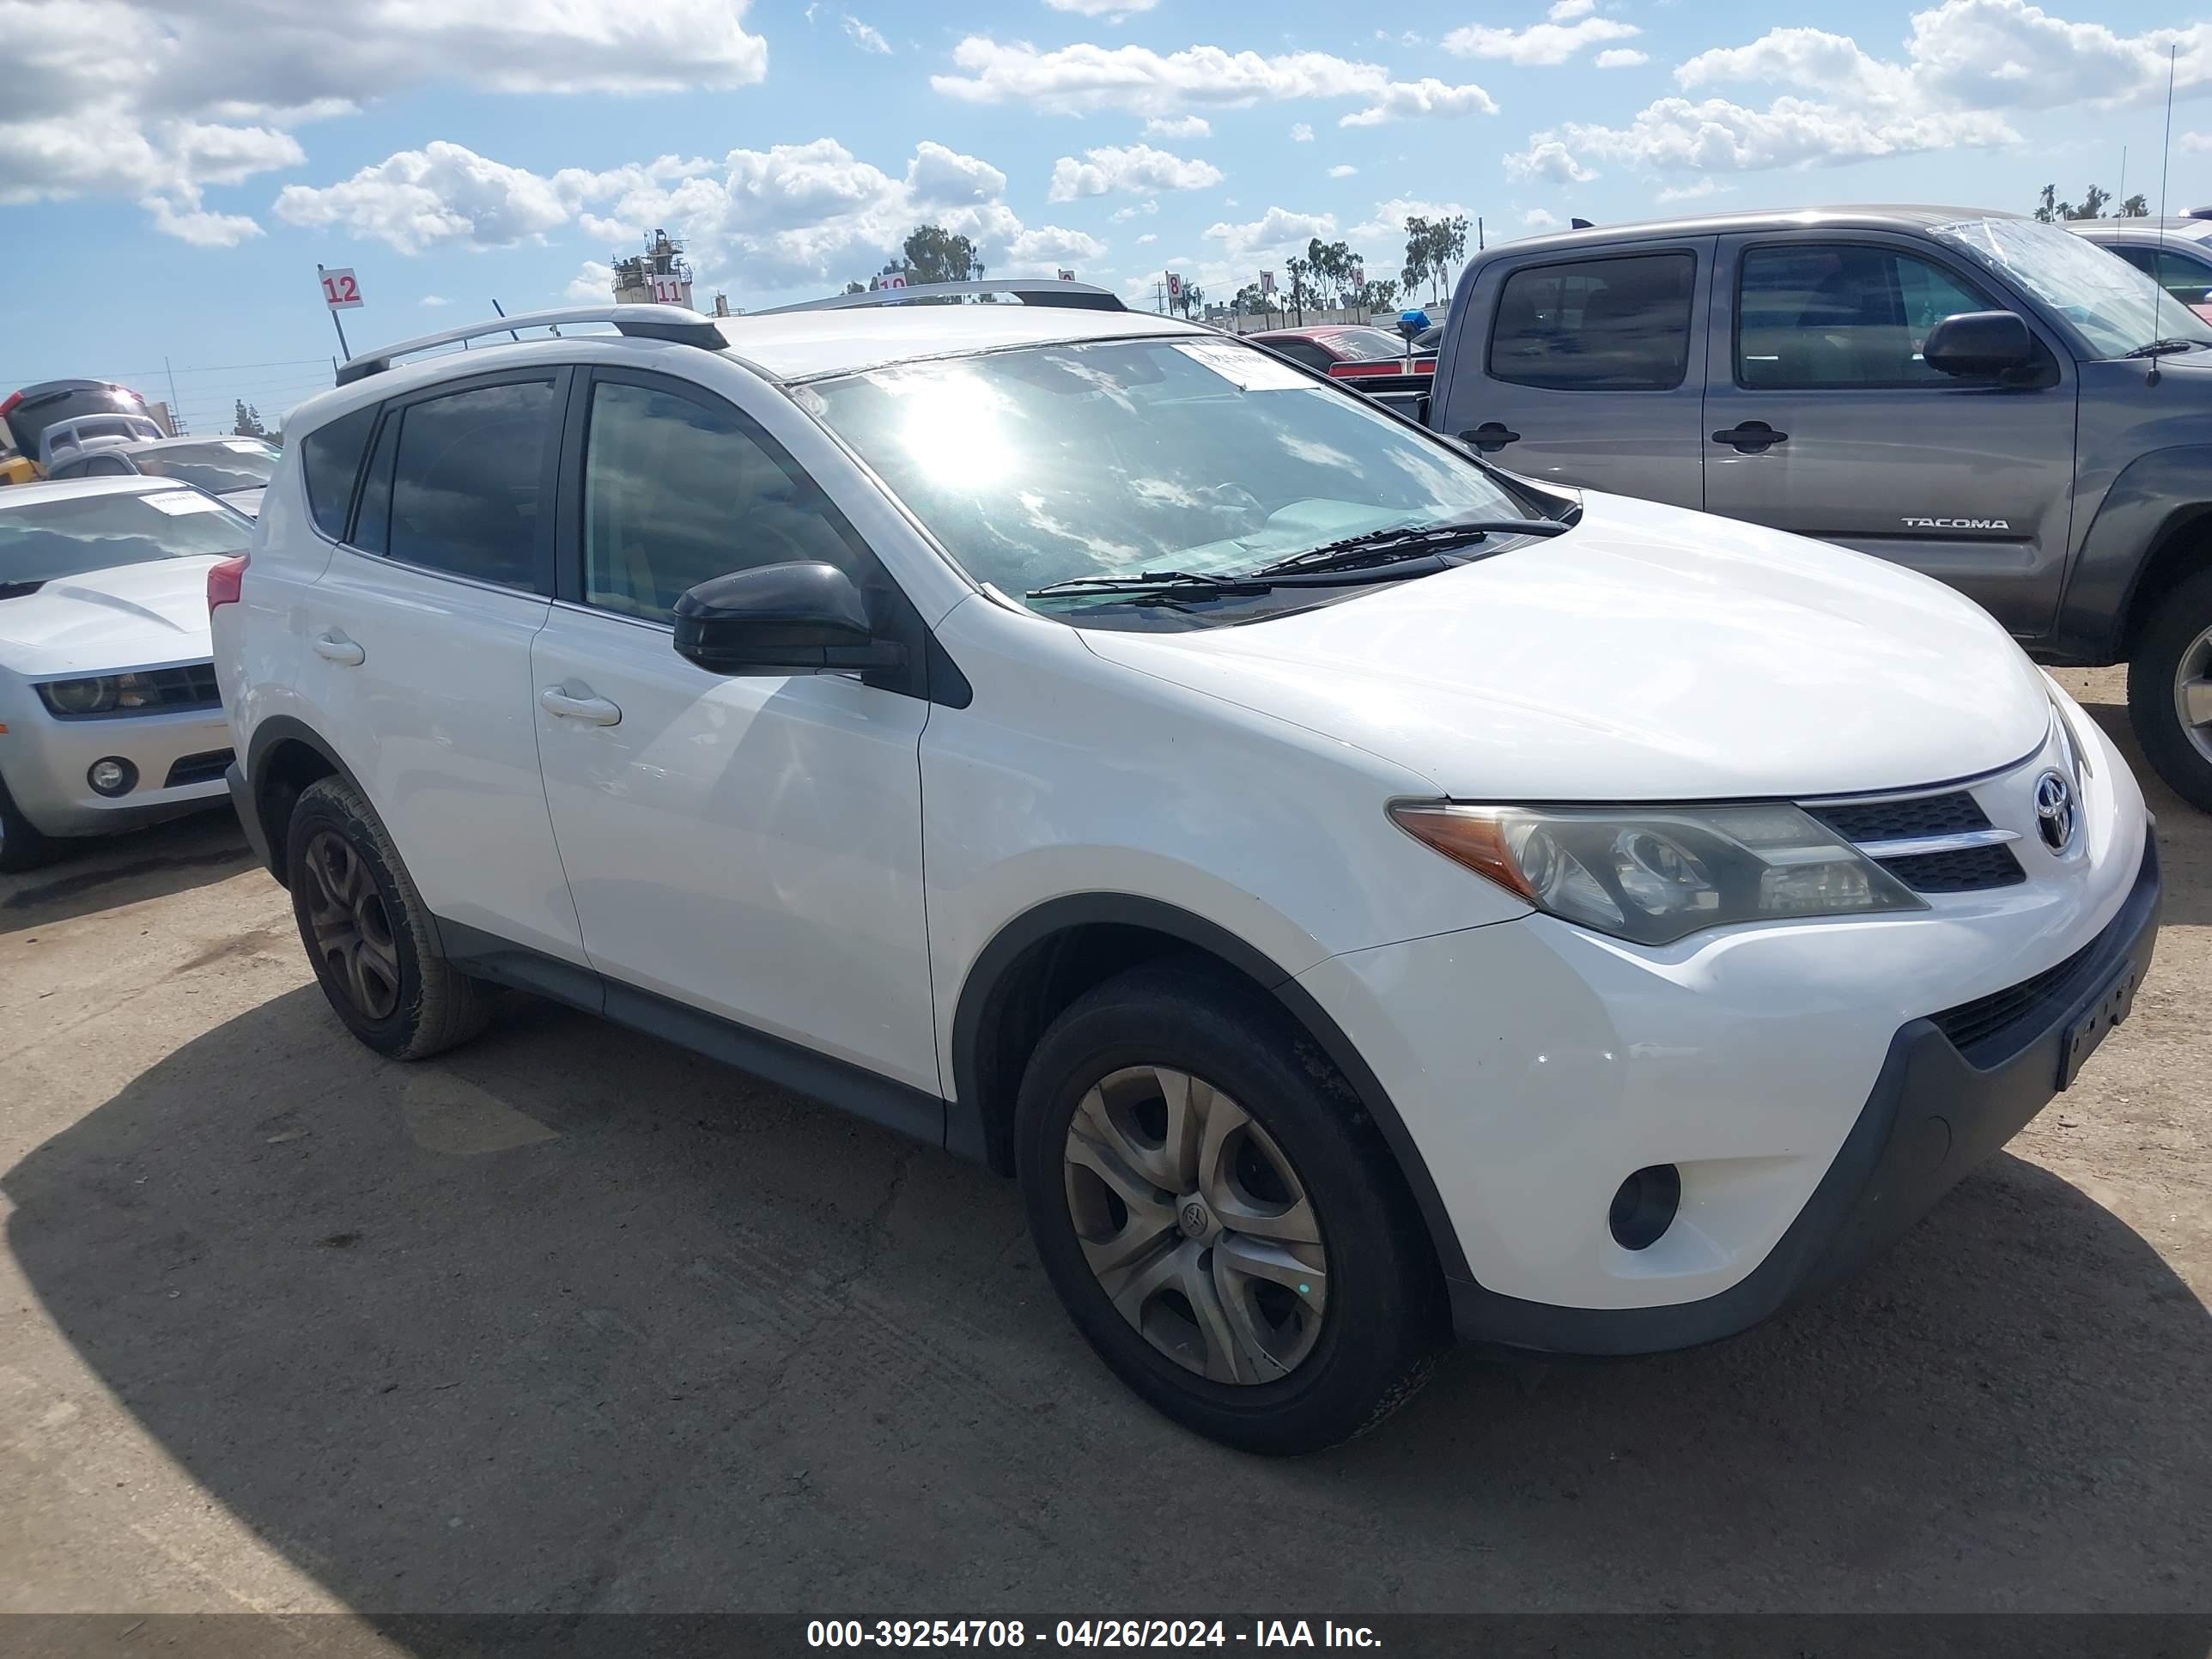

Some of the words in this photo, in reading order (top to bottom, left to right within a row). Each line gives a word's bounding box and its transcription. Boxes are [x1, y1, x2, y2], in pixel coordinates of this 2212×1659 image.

[1264, 275, 1271, 290] 7
[1357, 271, 1362, 286] 6
[1442, 267, 1447, 283] 5
[323, 276, 360, 303] 12
[657, 281, 683, 302] 11
[1170, 276, 1179, 295] 8
[1900, 517, 2009, 530] TACOMA
